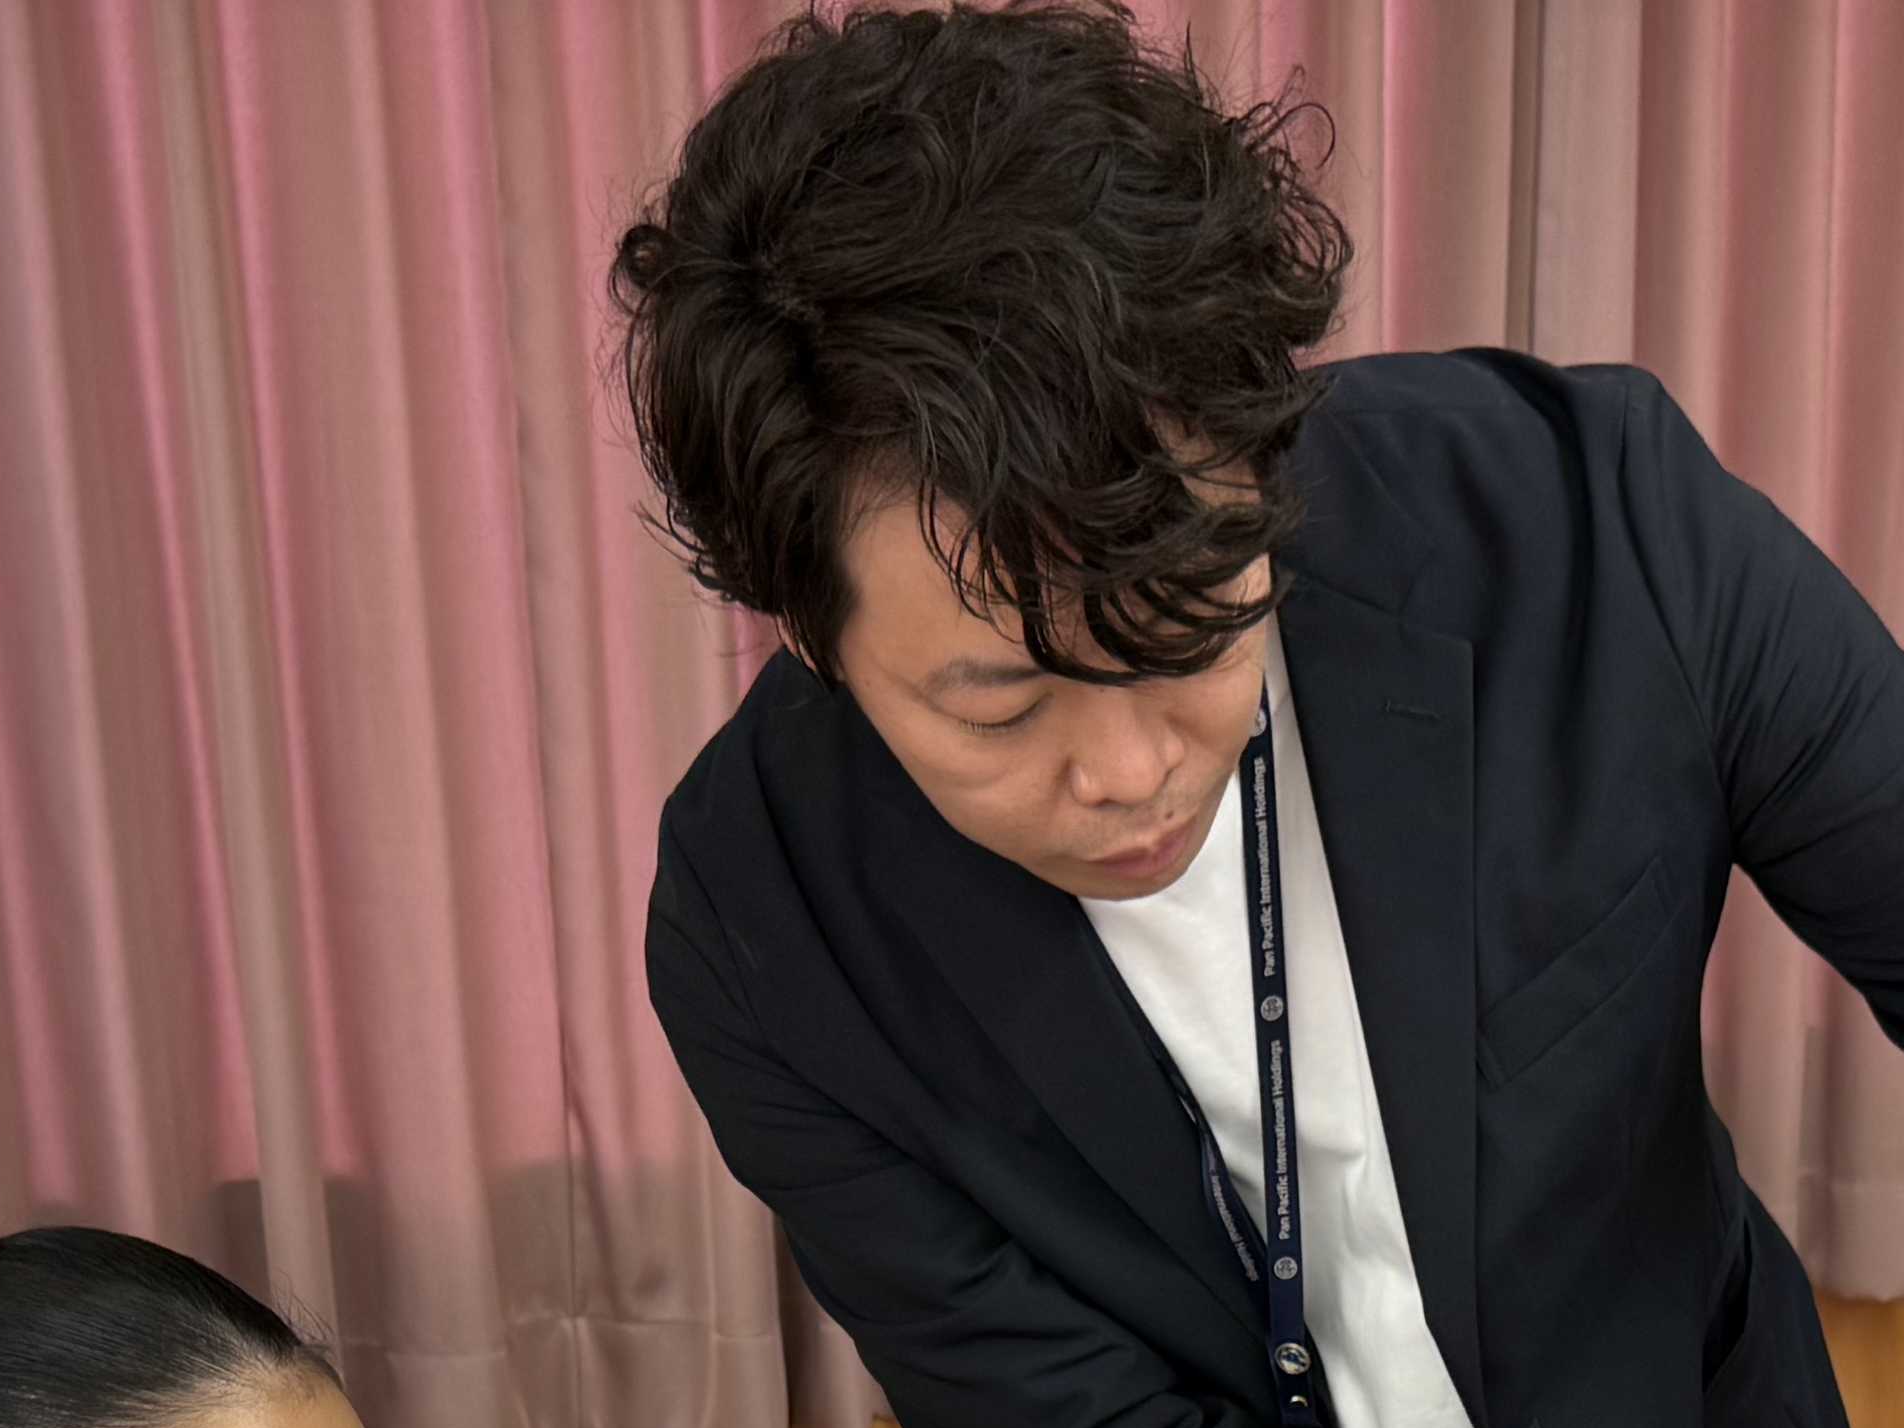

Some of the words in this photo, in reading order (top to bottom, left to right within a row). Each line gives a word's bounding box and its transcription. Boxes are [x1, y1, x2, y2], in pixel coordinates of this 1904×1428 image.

[1254, 757, 1268, 817] Holdings
[1258, 819, 1273, 908] International
[1271, 1039, 1284, 1091] Holdings
[1274, 1093, 1288, 1175] International
[1277, 1177, 1289, 1216] Pacific
[1279, 1218, 1290, 1240] Pan
